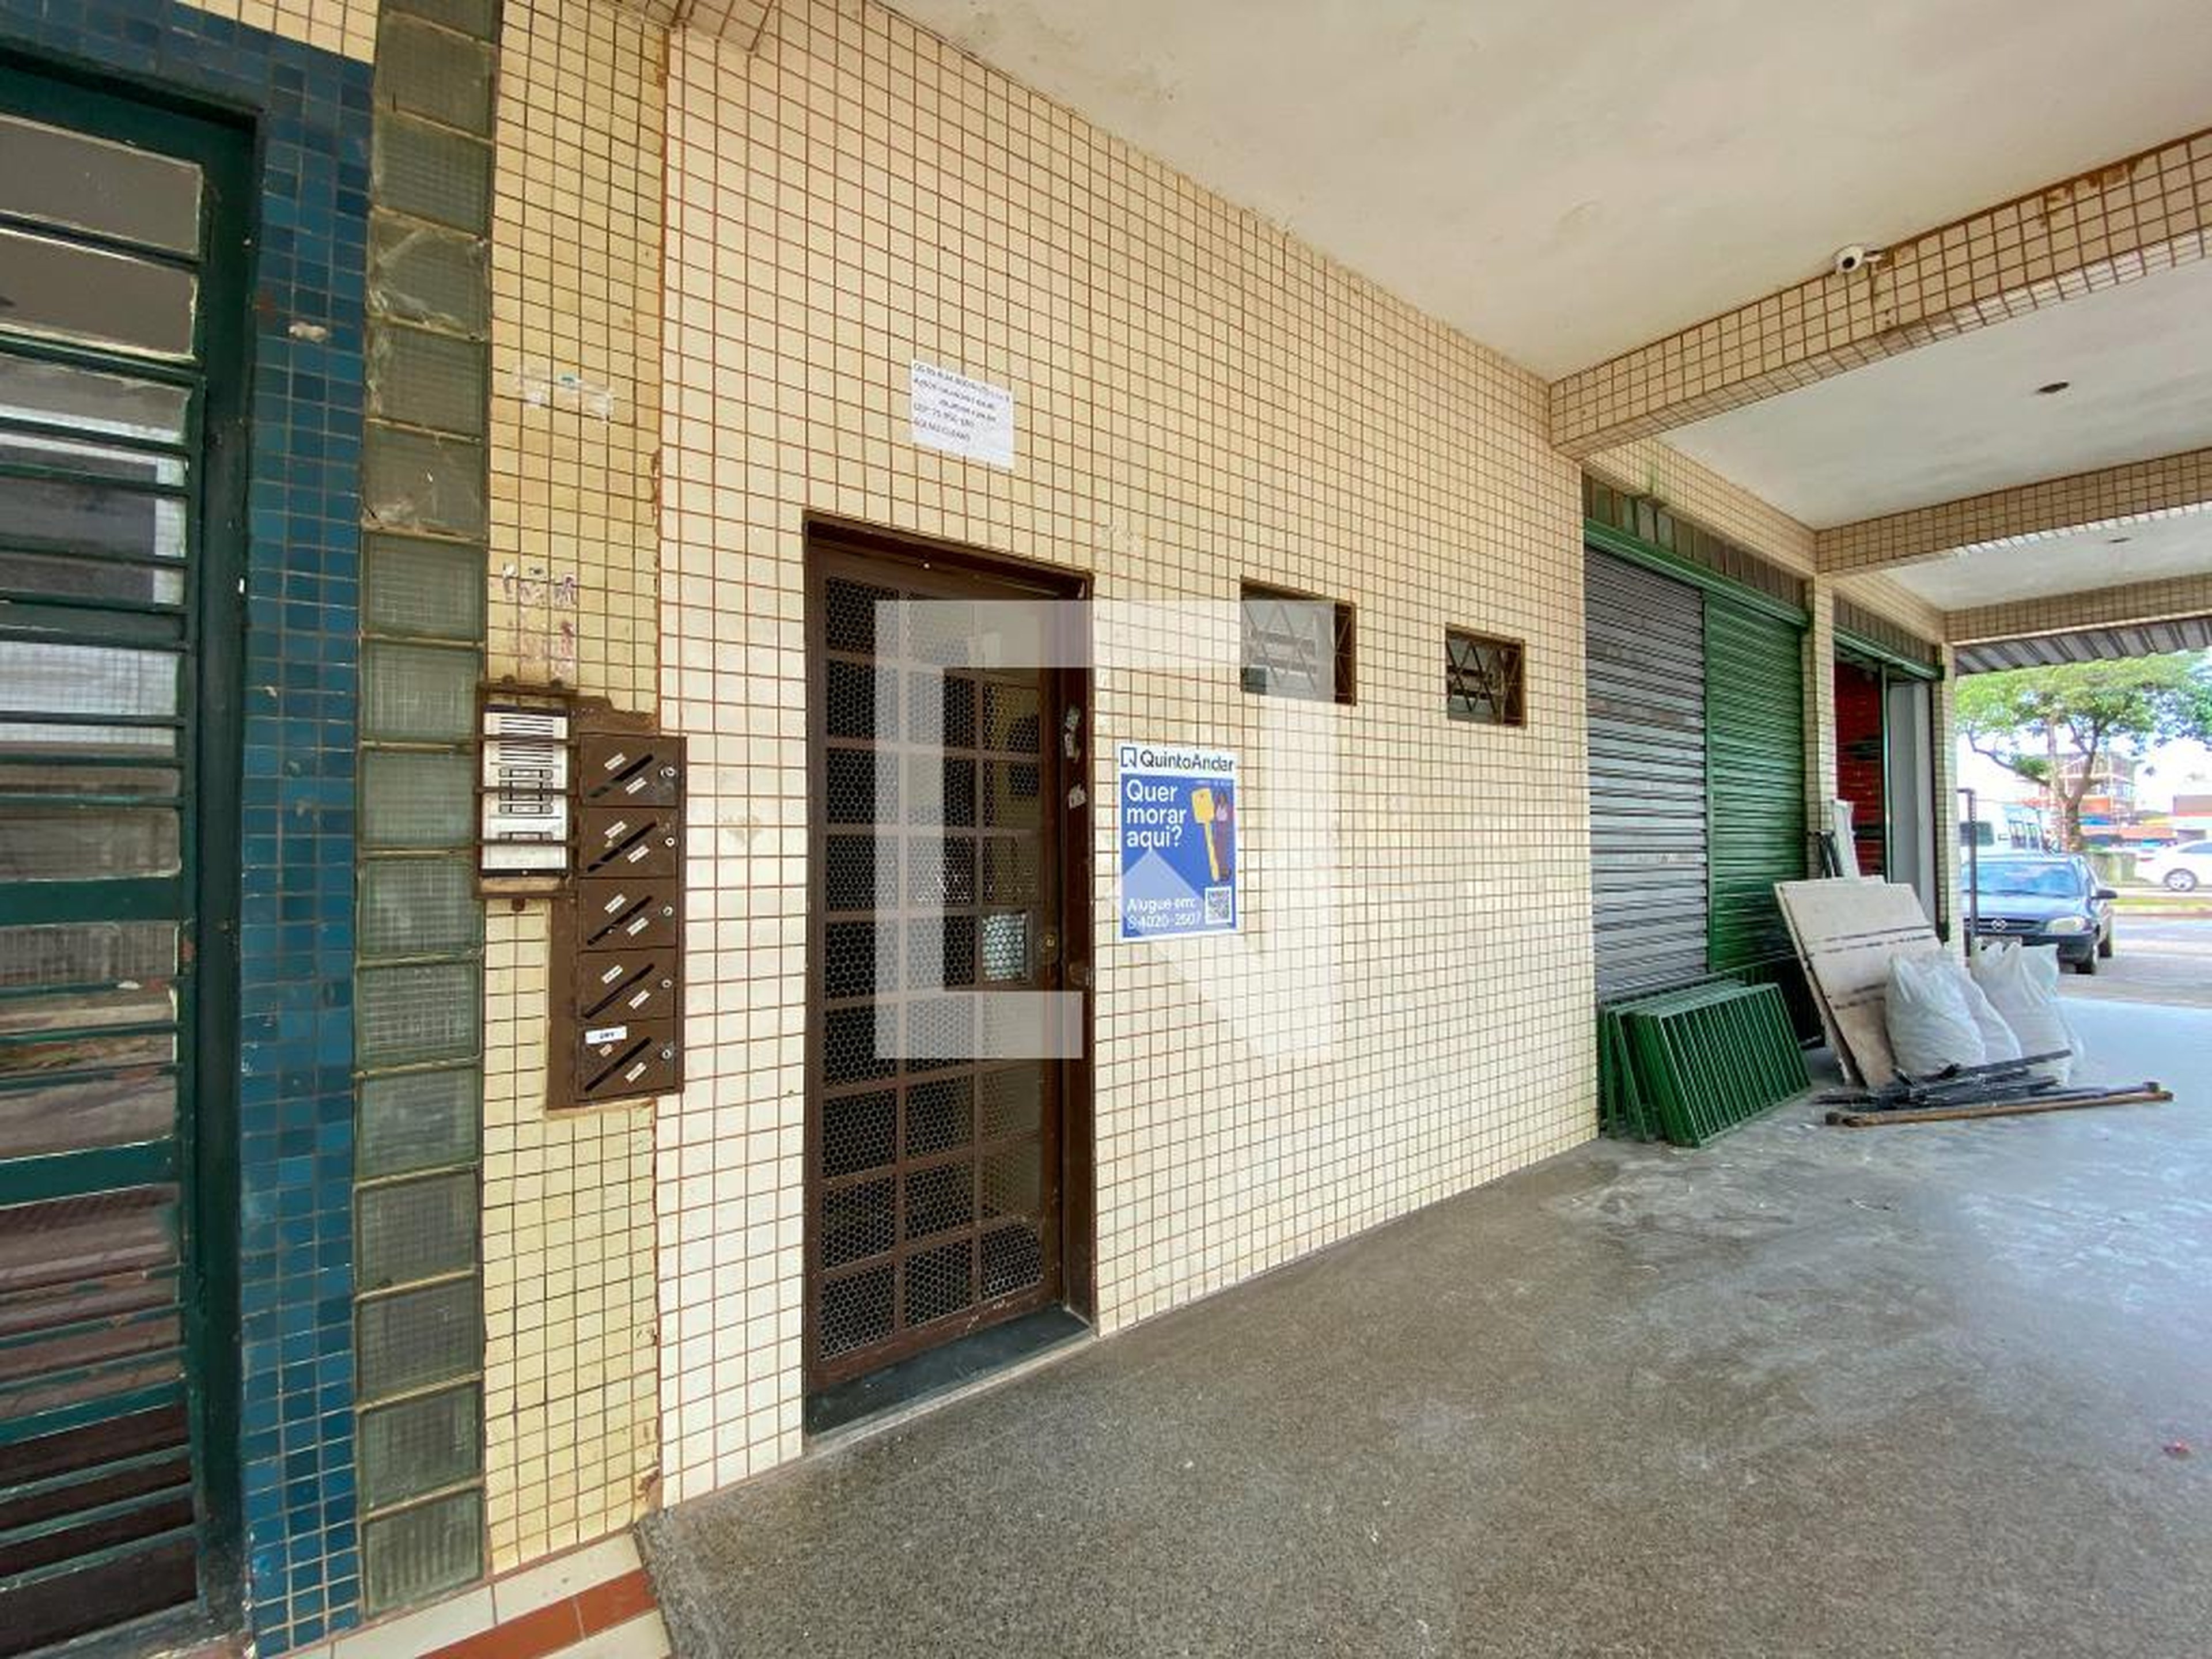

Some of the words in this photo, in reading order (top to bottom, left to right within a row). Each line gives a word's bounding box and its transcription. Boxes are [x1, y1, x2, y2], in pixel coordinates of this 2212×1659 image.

[1140, 749, 1233, 771] QuintoAndar
[1127, 779, 1177, 802] Quer
[1127, 808, 1187, 824] morar
[1127, 825, 1182, 850] aqui?
